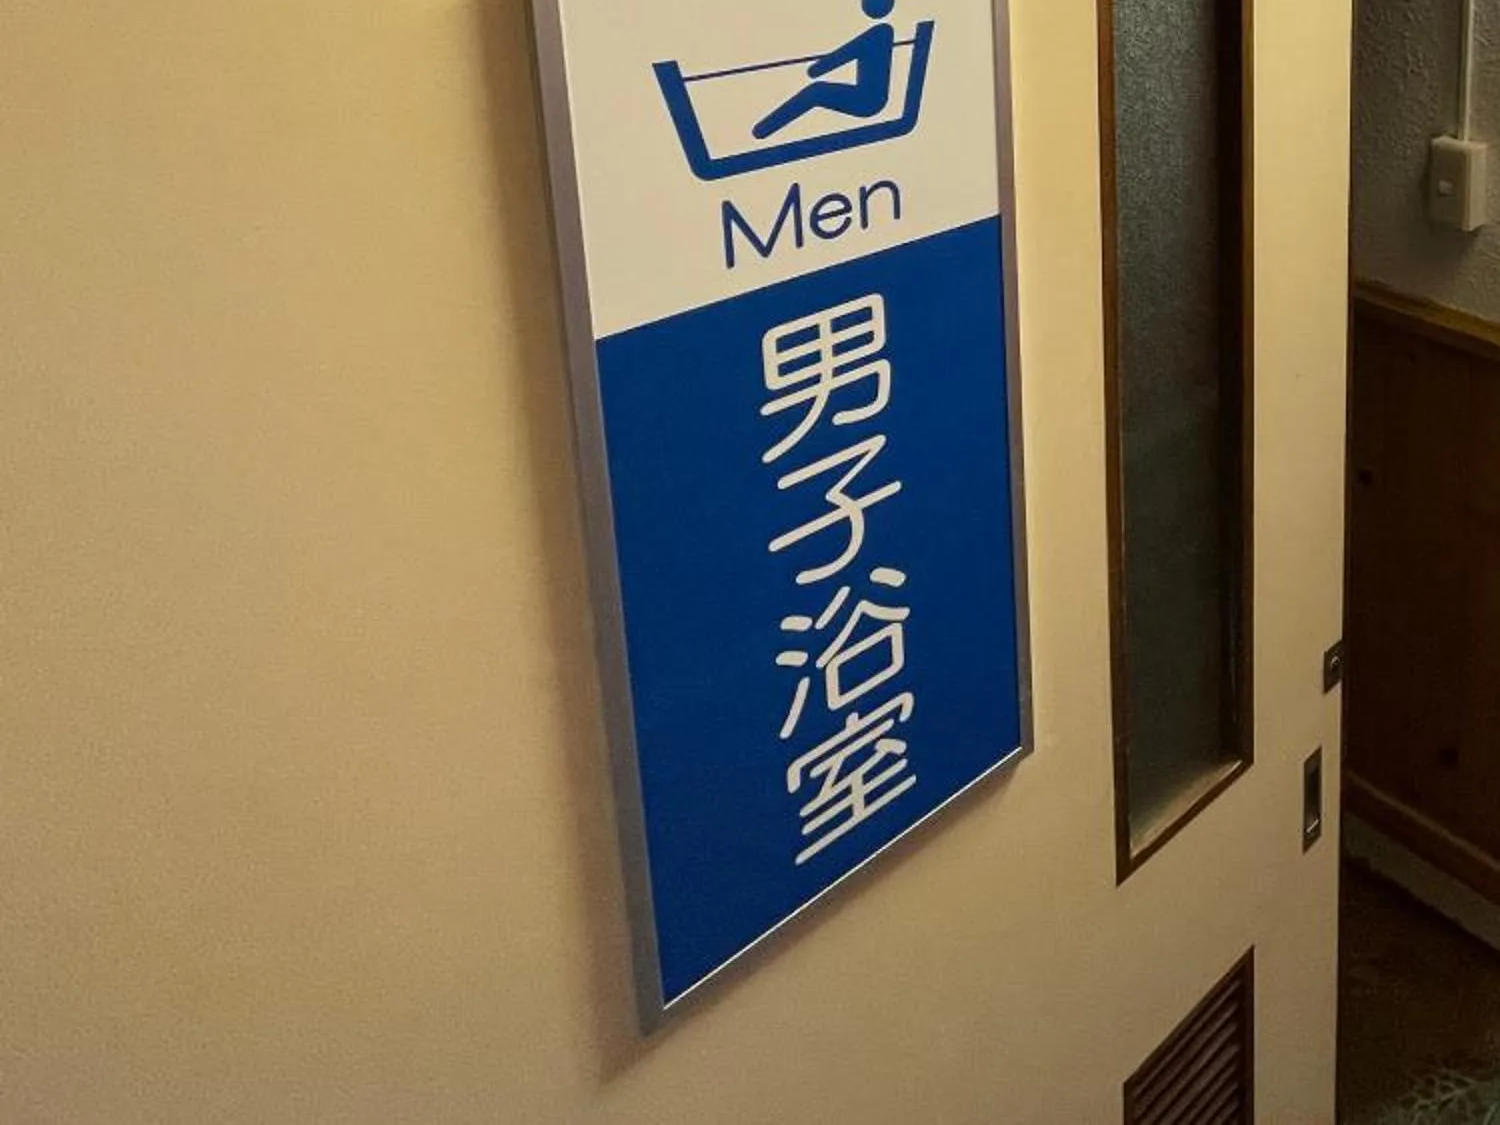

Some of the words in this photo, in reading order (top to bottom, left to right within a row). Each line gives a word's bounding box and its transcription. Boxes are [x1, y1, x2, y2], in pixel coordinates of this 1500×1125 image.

[721, 180, 901, 269] Men
[760, 293, 916, 864] 男子浴室
